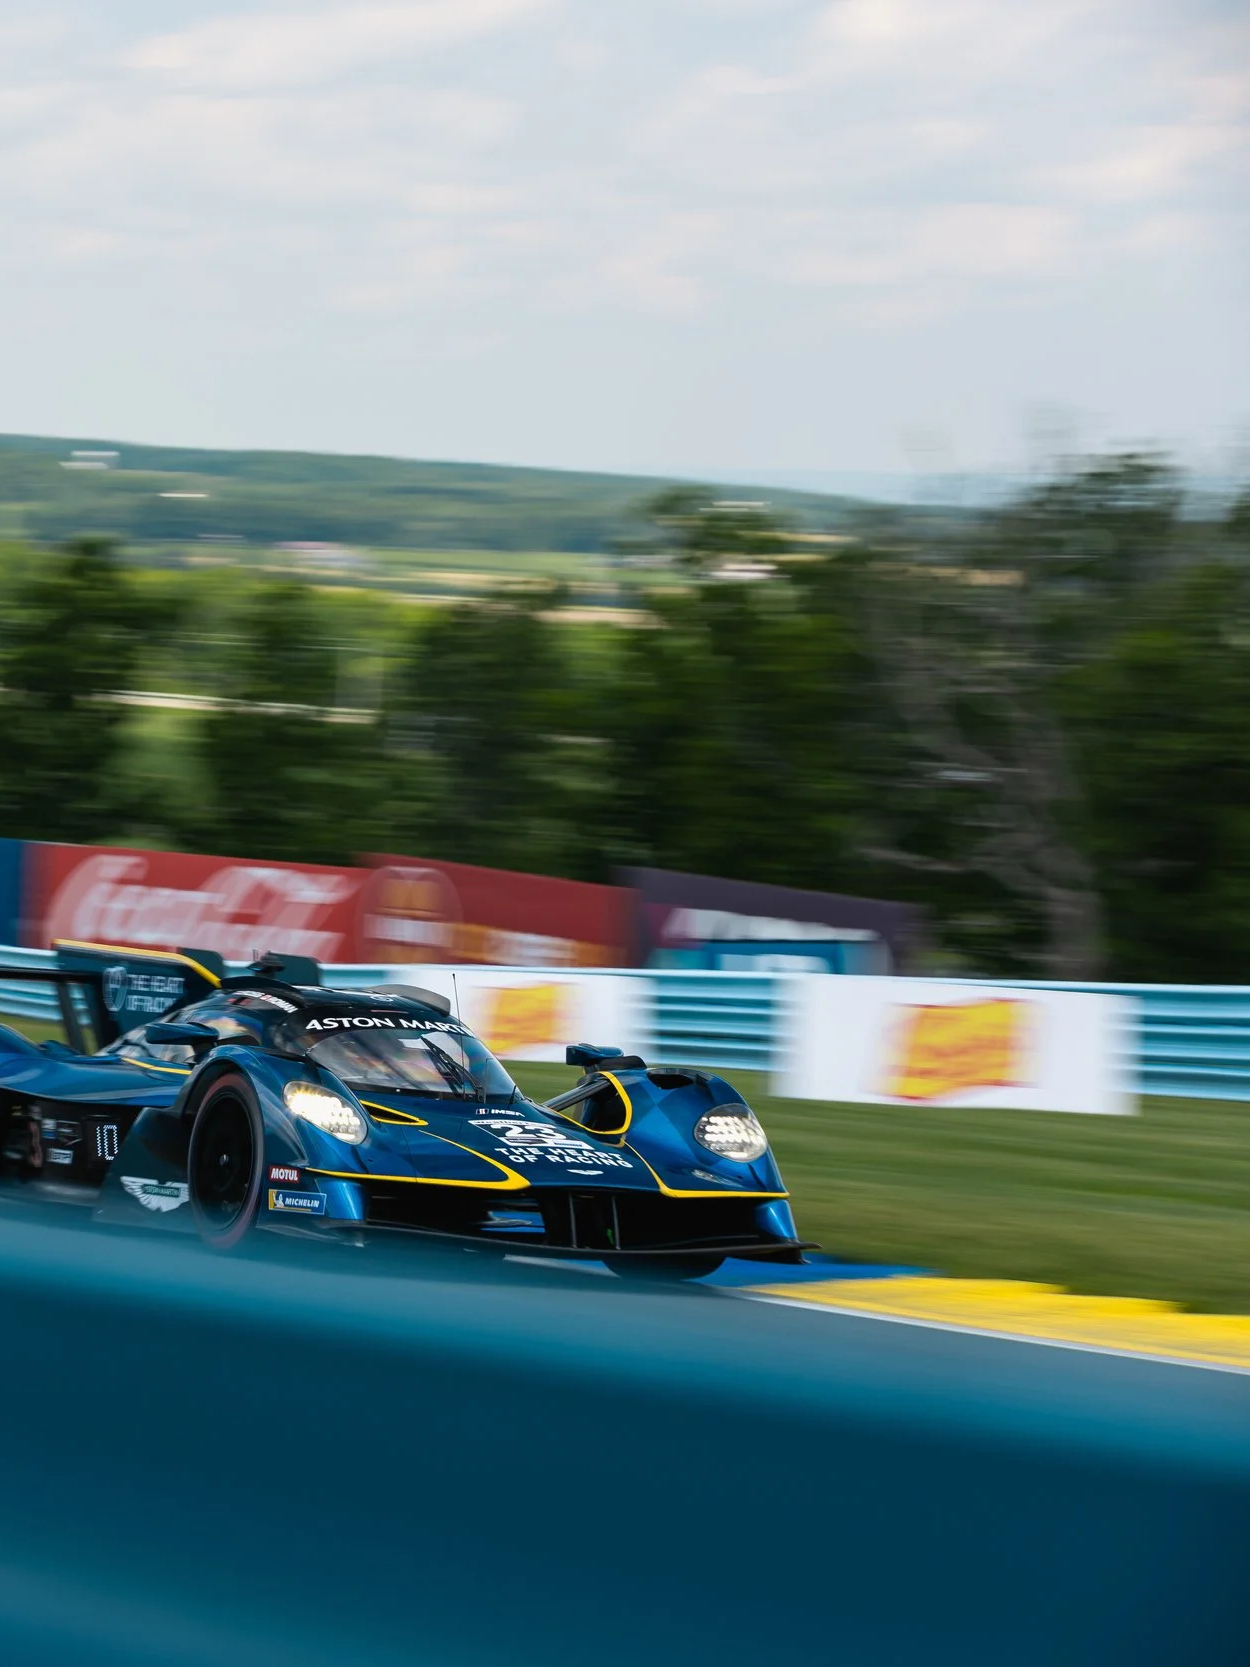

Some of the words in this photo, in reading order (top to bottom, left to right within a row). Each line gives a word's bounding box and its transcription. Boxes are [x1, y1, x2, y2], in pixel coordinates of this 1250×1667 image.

[305, 1017, 395, 1030] ASTON
[491, 1109, 526, 1117] IMSA
[490, 1124, 567, 1140] 23
[96, 1125, 119, 1160] 10
[548, 1148, 623, 1160] HEART
[508, 1155, 538, 1163] OF
[545, 1155, 633, 1168] RACING
[271, 1168, 298, 1180] MOTUL
[285, 1198, 320, 1207] MICHELIN
